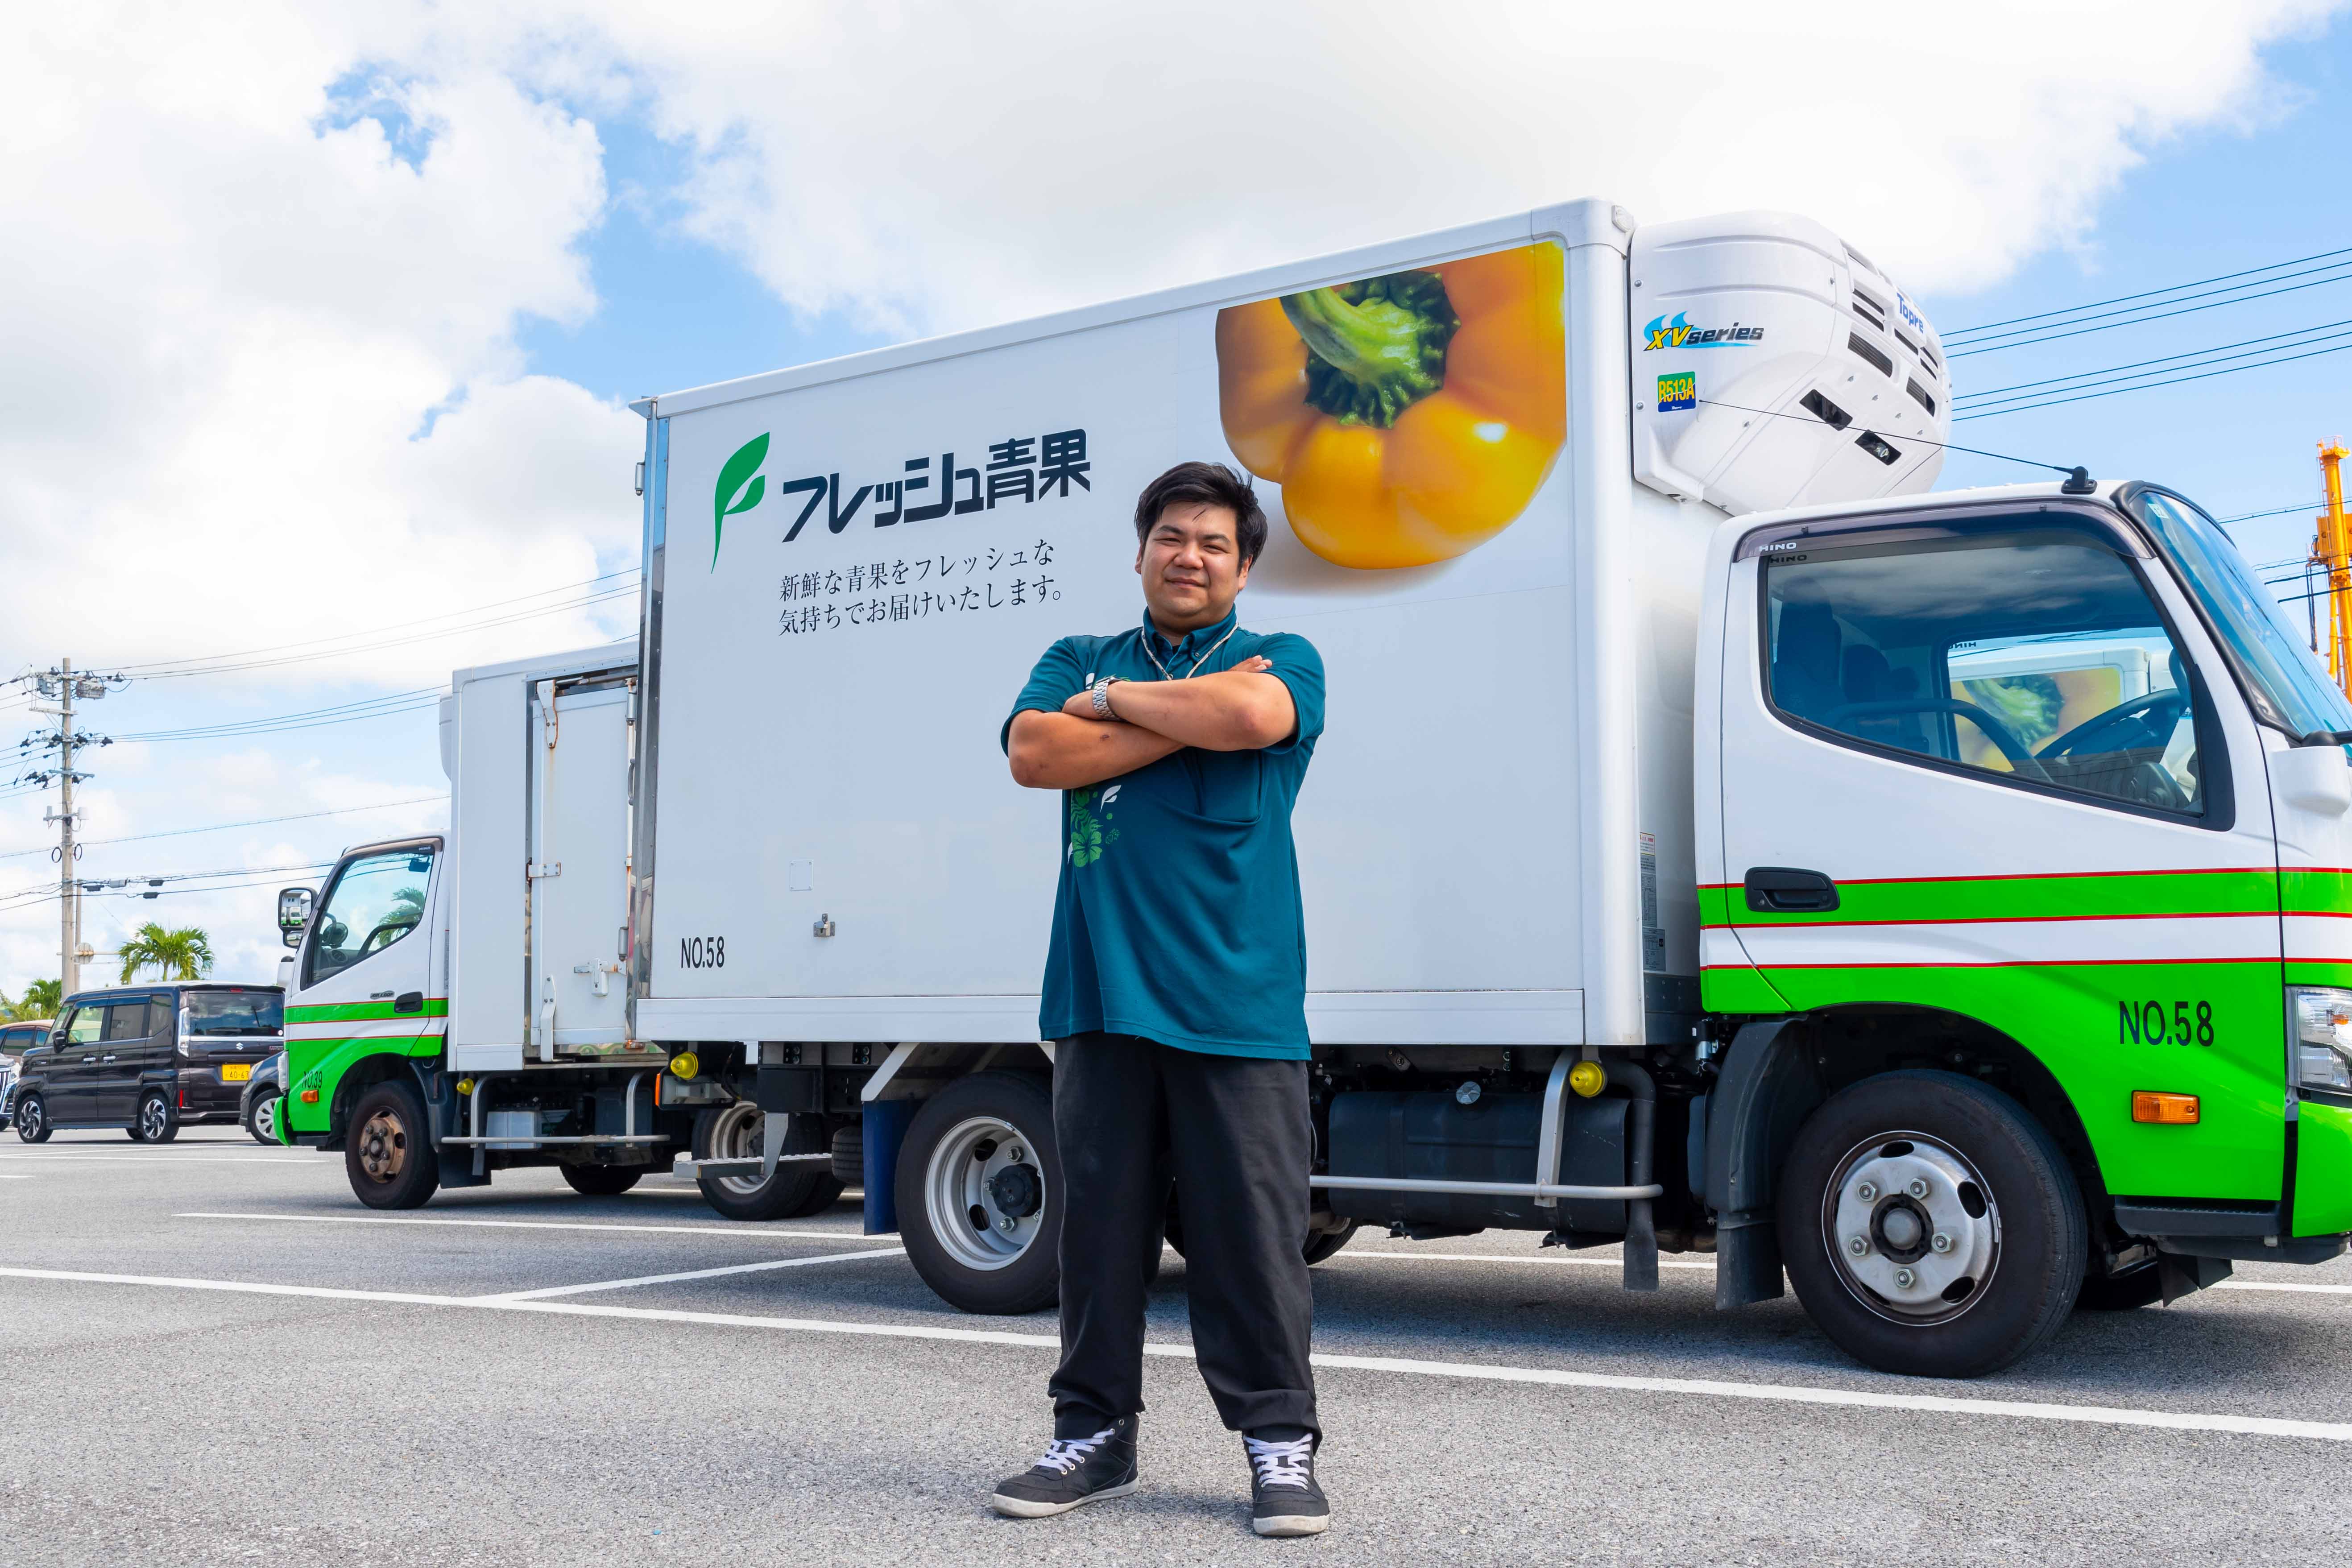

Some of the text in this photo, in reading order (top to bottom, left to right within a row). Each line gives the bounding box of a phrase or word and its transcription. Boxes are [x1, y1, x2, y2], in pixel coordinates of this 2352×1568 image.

[1897, 292, 1924, 334] Topre
[1658, 377, 1695, 403] R513A
[782, 429, 1090, 543] フレッシュ青果
[1759, 542, 1797, 552] HINO
[1770, 554, 1807, 563] HINO
[779, 539, 1054, 602] 新鮮な青果をフレッシュな
[779, 575, 1061, 637] 気持ちでお届けいたします。
[681, 936, 725, 968] NO.58
[2119, 1001, 2214, 1047] NO.58
[302, 1071, 322, 1088] NO.39
